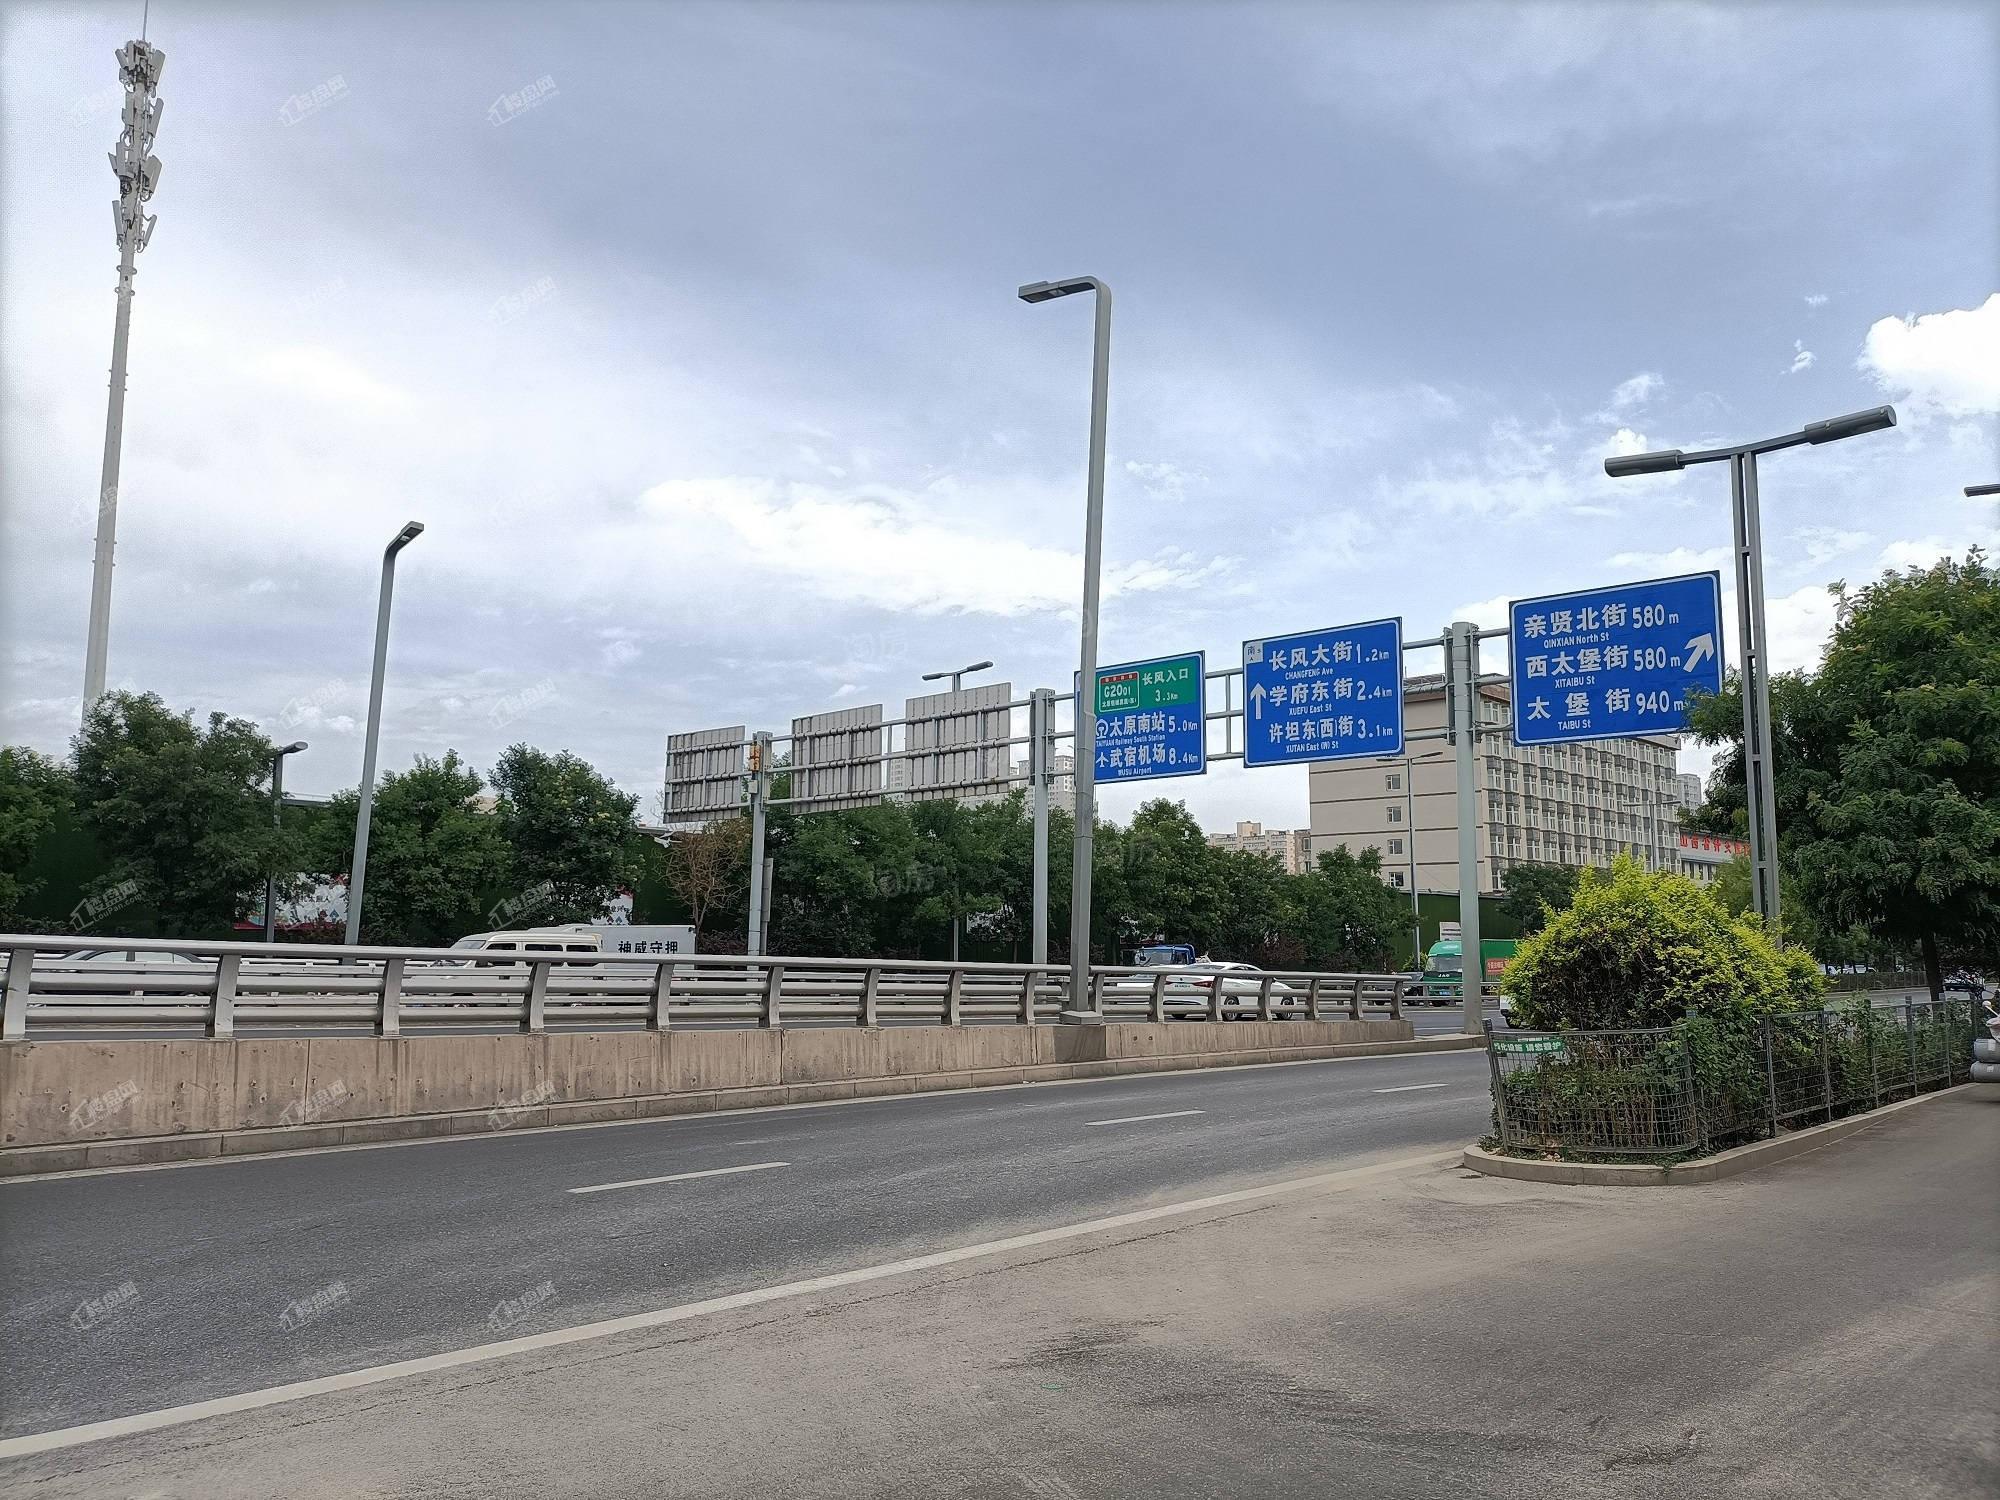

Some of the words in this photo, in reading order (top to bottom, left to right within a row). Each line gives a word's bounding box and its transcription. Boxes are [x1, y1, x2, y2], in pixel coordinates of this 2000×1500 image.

[1523, 602, 1626, 639] 亲贤北街
[1543, 635, 1575, 649] QINXIAN
[1576, 633, 1599, 646] North
[1600, 631, 1610, 642] St
[1268, 640, 1352, 672] 长风大街
[1356, 643, 1390, 664] 1.2km
[1525, 645, 1629, 679] 西太堡街
[1142, 668, 1189, 686] 长风入口
[1285, 668, 1320, 680] CHANGFENG
[1321, 667, 1334, 676] Ave
[1554, 676, 1584, 689] XITAIBU
[1586, 675, 1595, 685] St
[1103, 684, 1131, 698] G2001
[1269, 677, 1353, 707] 学府东街
[1356, 680, 1393, 701] 2.4km
[1288, 705, 1309, 717] XUEFU
[1309, 704, 1323, 714] East
[1325, 703, 1333, 712] St
[1109, 710, 1166, 737] 太原南站
[1269, 715, 1354, 744] 许坦东(西)街
[1357, 718, 1393, 739] 3.1km
[1557, 720, 1580, 731] TAIBU
[1582, 719, 1592, 729] St
[1115, 737, 1133, 746] Railway
[1134, 735, 1147, 743] South
[1148, 733, 1166, 742] Station
[1285, 743, 1305, 754] XUTAN
[1306, 742, 1320, 752] East
[1331, 740, 1340, 749] St
[1109, 743, 1166, 768] 武宿机场
[1118, 768, 1133, 777] WUSU
[1133, 766, 1152, 776] Airport
[618, 941, 678, 954] 神威守押
